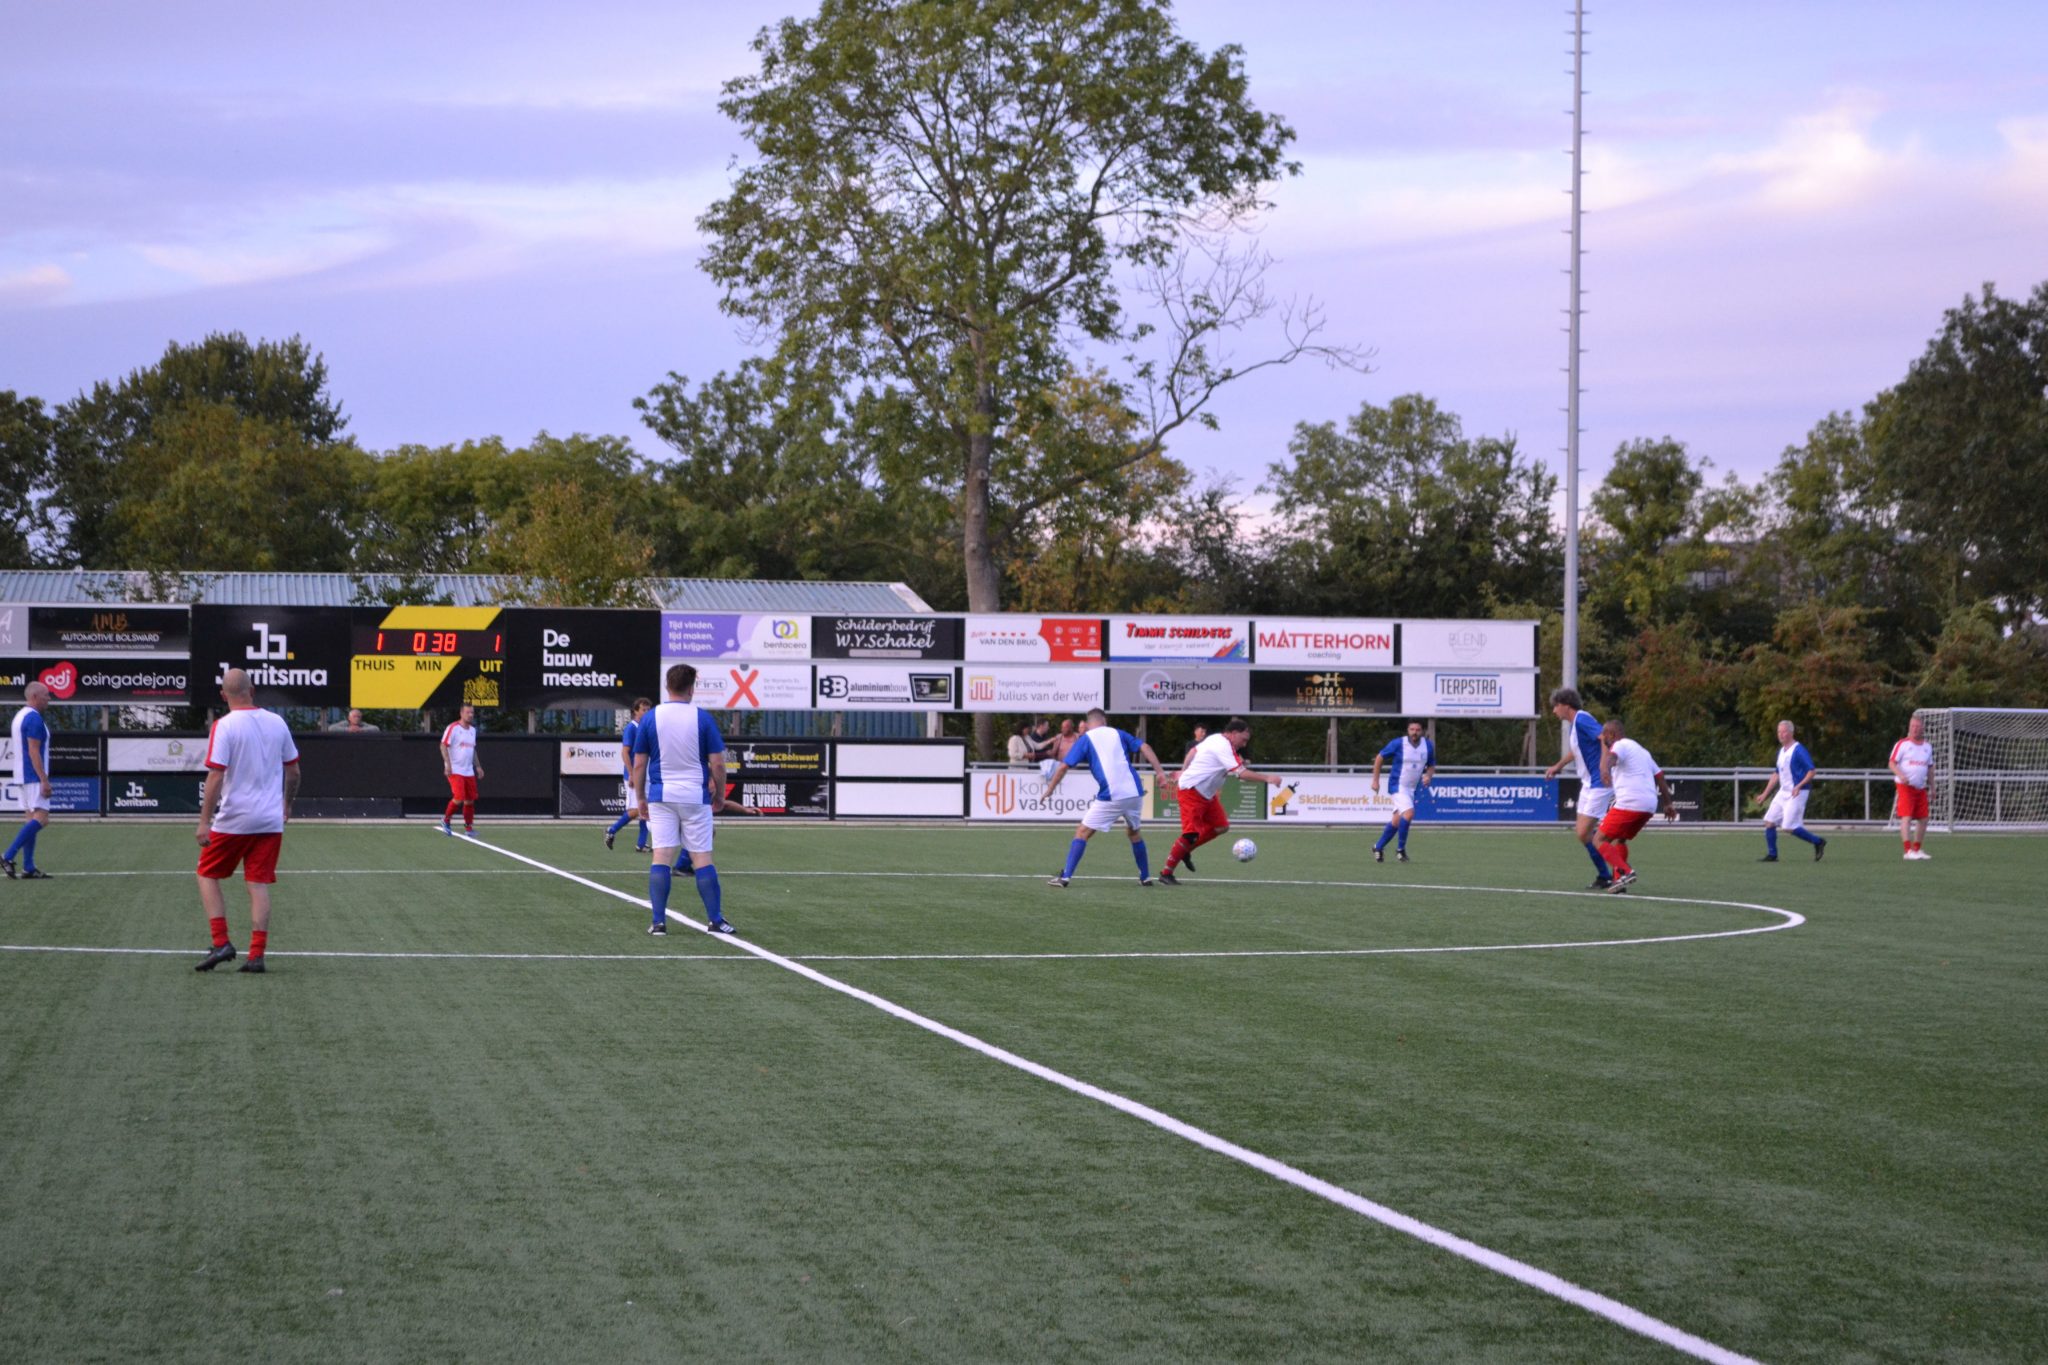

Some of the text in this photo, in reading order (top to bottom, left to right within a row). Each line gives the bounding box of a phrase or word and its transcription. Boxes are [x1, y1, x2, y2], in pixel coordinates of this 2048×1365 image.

[668, 621, 683, 631] Tijd
[836, 619, 936, 634] Schildersbedrijf
[61, 633, 160, 642] AUTOMOTIVE BOLSWARD
[377, 632, 384, 651] 1
[495, 634, 501, 653] 1
[543, 629, 570, 647] De
[1017, 639, 1037, 647] BRUG
[1259, 628, 1390, 650] MATTERHORN
[543, 648, 593, 667] bouw
[1307, 651, 1341, 660] coaching
[354, 660, 503, 673] THUIS MIN UIT
[215, 662, 327, 686] Jrritsma
[543, 671, 623, 687] meester.
[82, 672, 186, 689] osingadejong
[998, 680, 1056, 689] Tegelgroothandel
[1160, 680, 1222, 692] Rijschool
[1440, 678, 1497, 695] TERPSTRA
[851, 682, 908, 693] aluminiumbouw
[1296, 687, 1353, 696] LOHMAN
[998, 691, 1099, 702] Julius van der Werf
[1146, 691, 1185, 700] Richard
[1296, 697, 1353, 706] FIETSEN
[577, 748, 617, 758] Pienter
[743, 784, 786, 794] AUTOBEDRIJF
[1429, 786, 1543, 799] VRIENDENLOTERIJ
[742, 794, 786, 808] DE VRIES
[1299, 795, 1395, 805] Skilderwurk Rin
